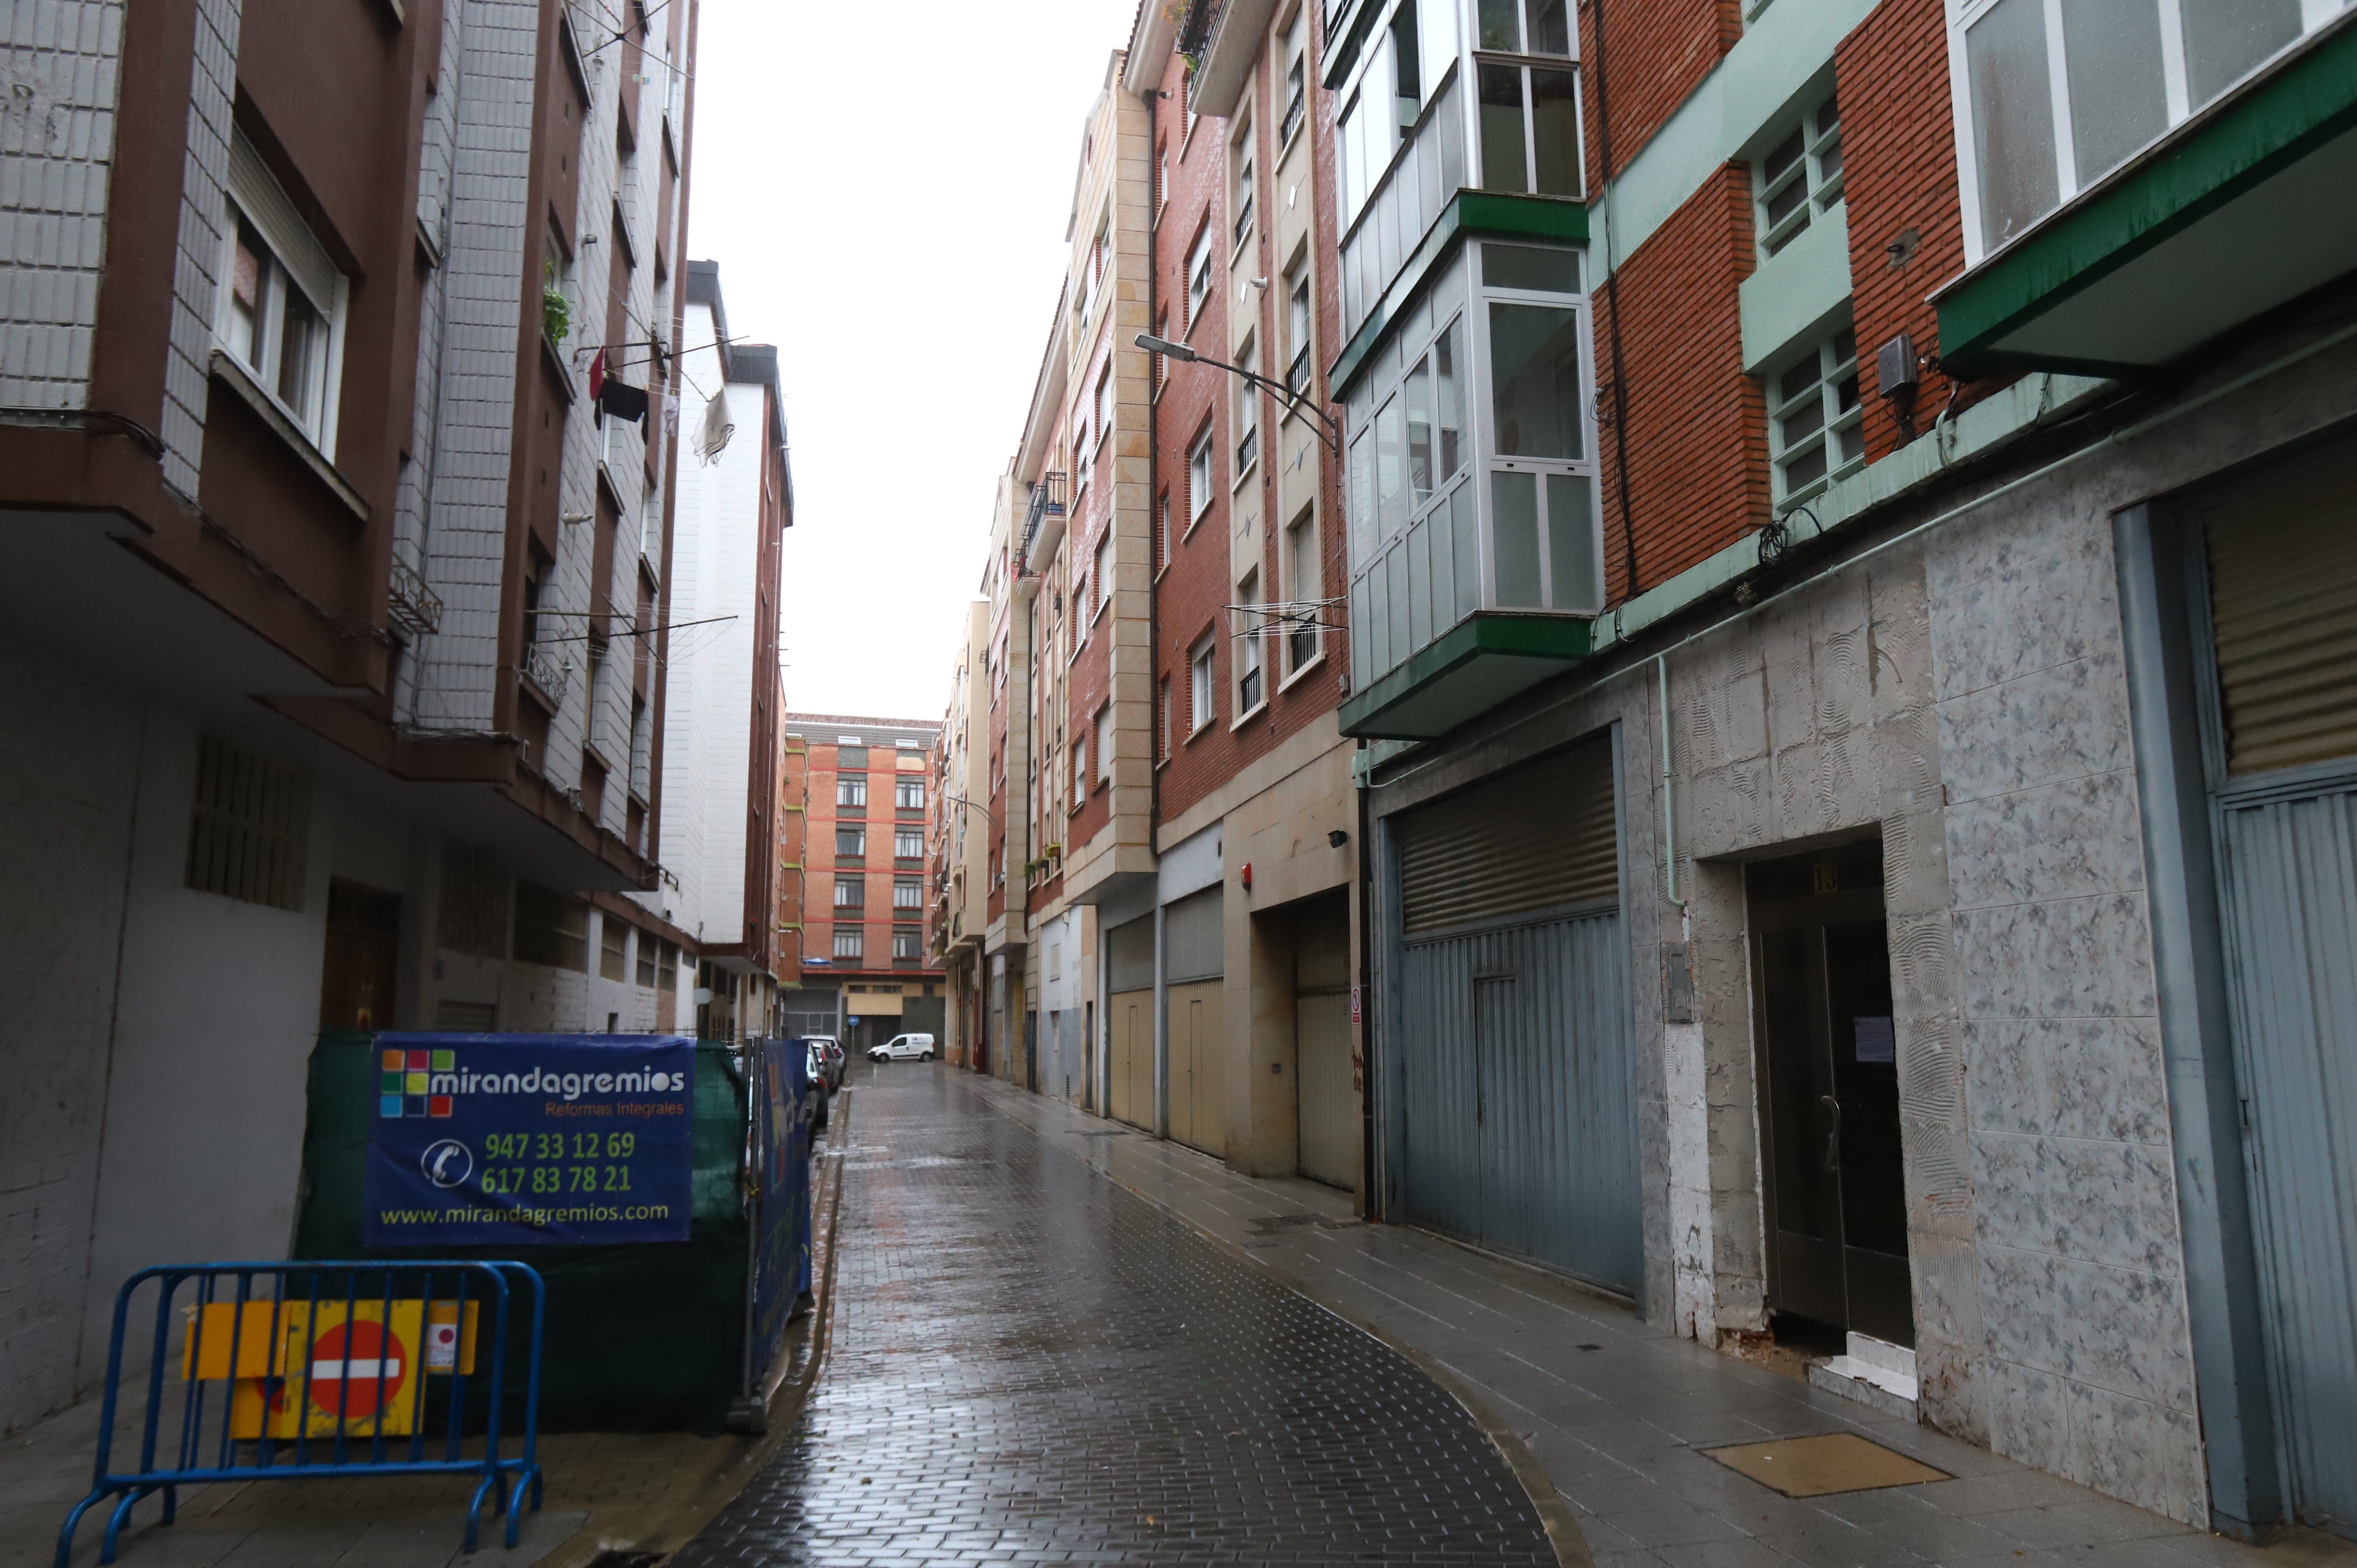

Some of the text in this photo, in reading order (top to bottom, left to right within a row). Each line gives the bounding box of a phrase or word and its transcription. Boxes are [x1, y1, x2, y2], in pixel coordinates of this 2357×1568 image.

[1815, 864, 1836, 891] 13
[431, 1065, 685, 1101] mirandagremios
[545, 1100, 684, 1119] Reformas Integrales
[485, 1132, 635, 1160] 947 33 12 69
[482, 1165, 632, 1194] 617 83 78 21
[381, 1203, 669, 1227] www.mirandagremios.com
